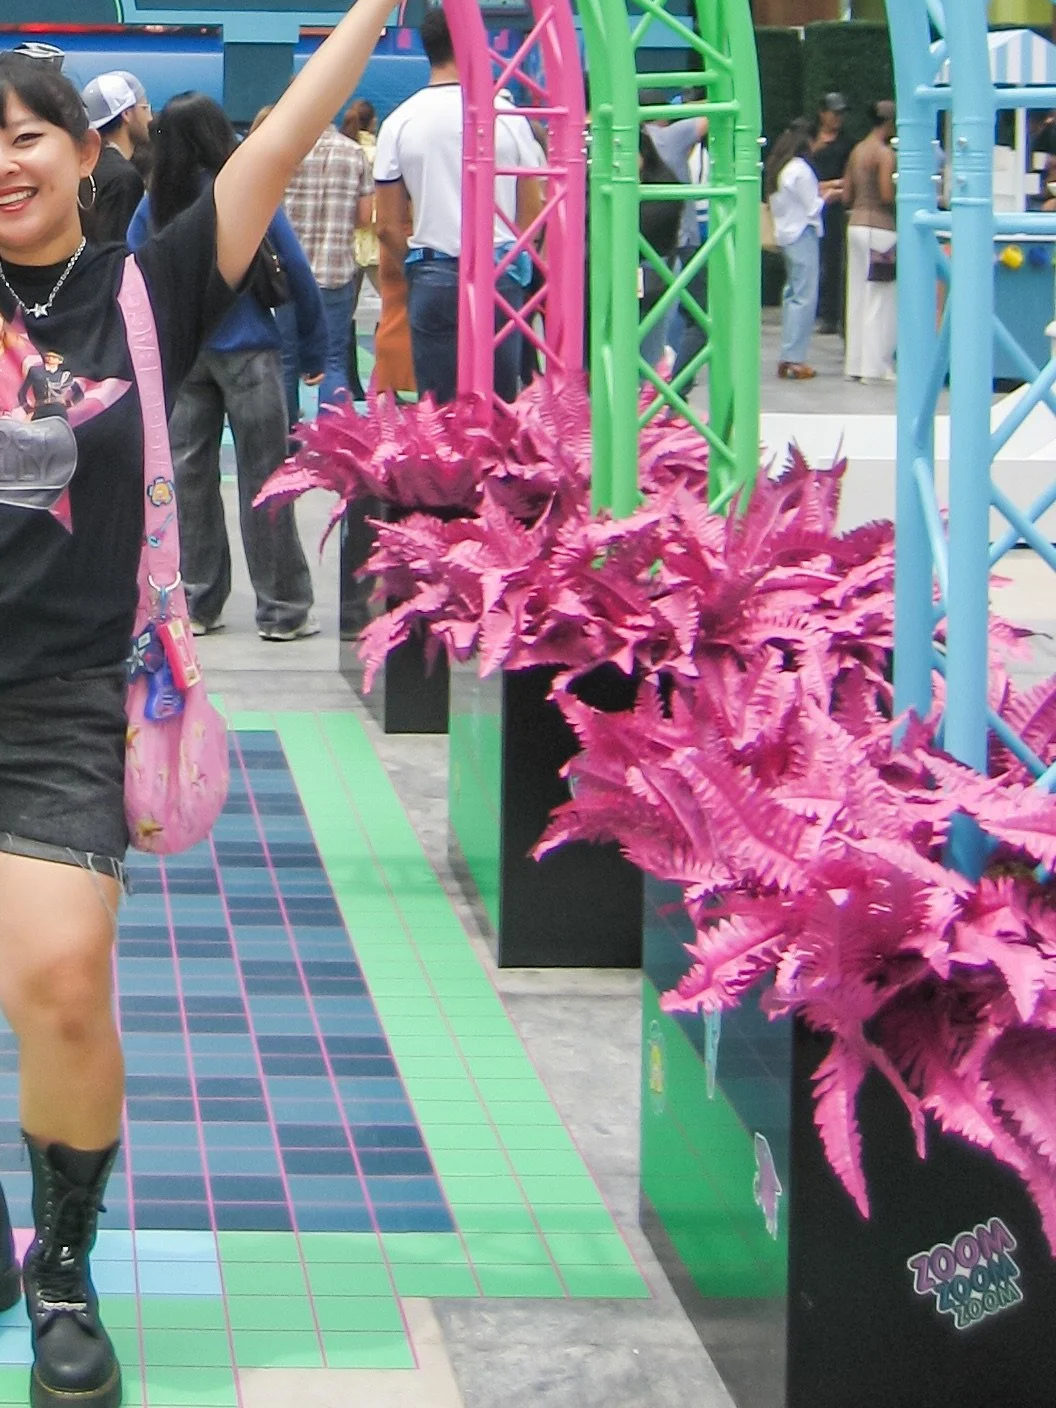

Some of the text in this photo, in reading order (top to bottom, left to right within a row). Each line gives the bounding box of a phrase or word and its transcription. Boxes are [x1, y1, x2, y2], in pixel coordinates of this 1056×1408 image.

[909, 1218, 1017, 1292] ZOOM
[933, 1251, 1020, 1311] ZOOM
[953, 1280, 1023, 1326] ZOOM
